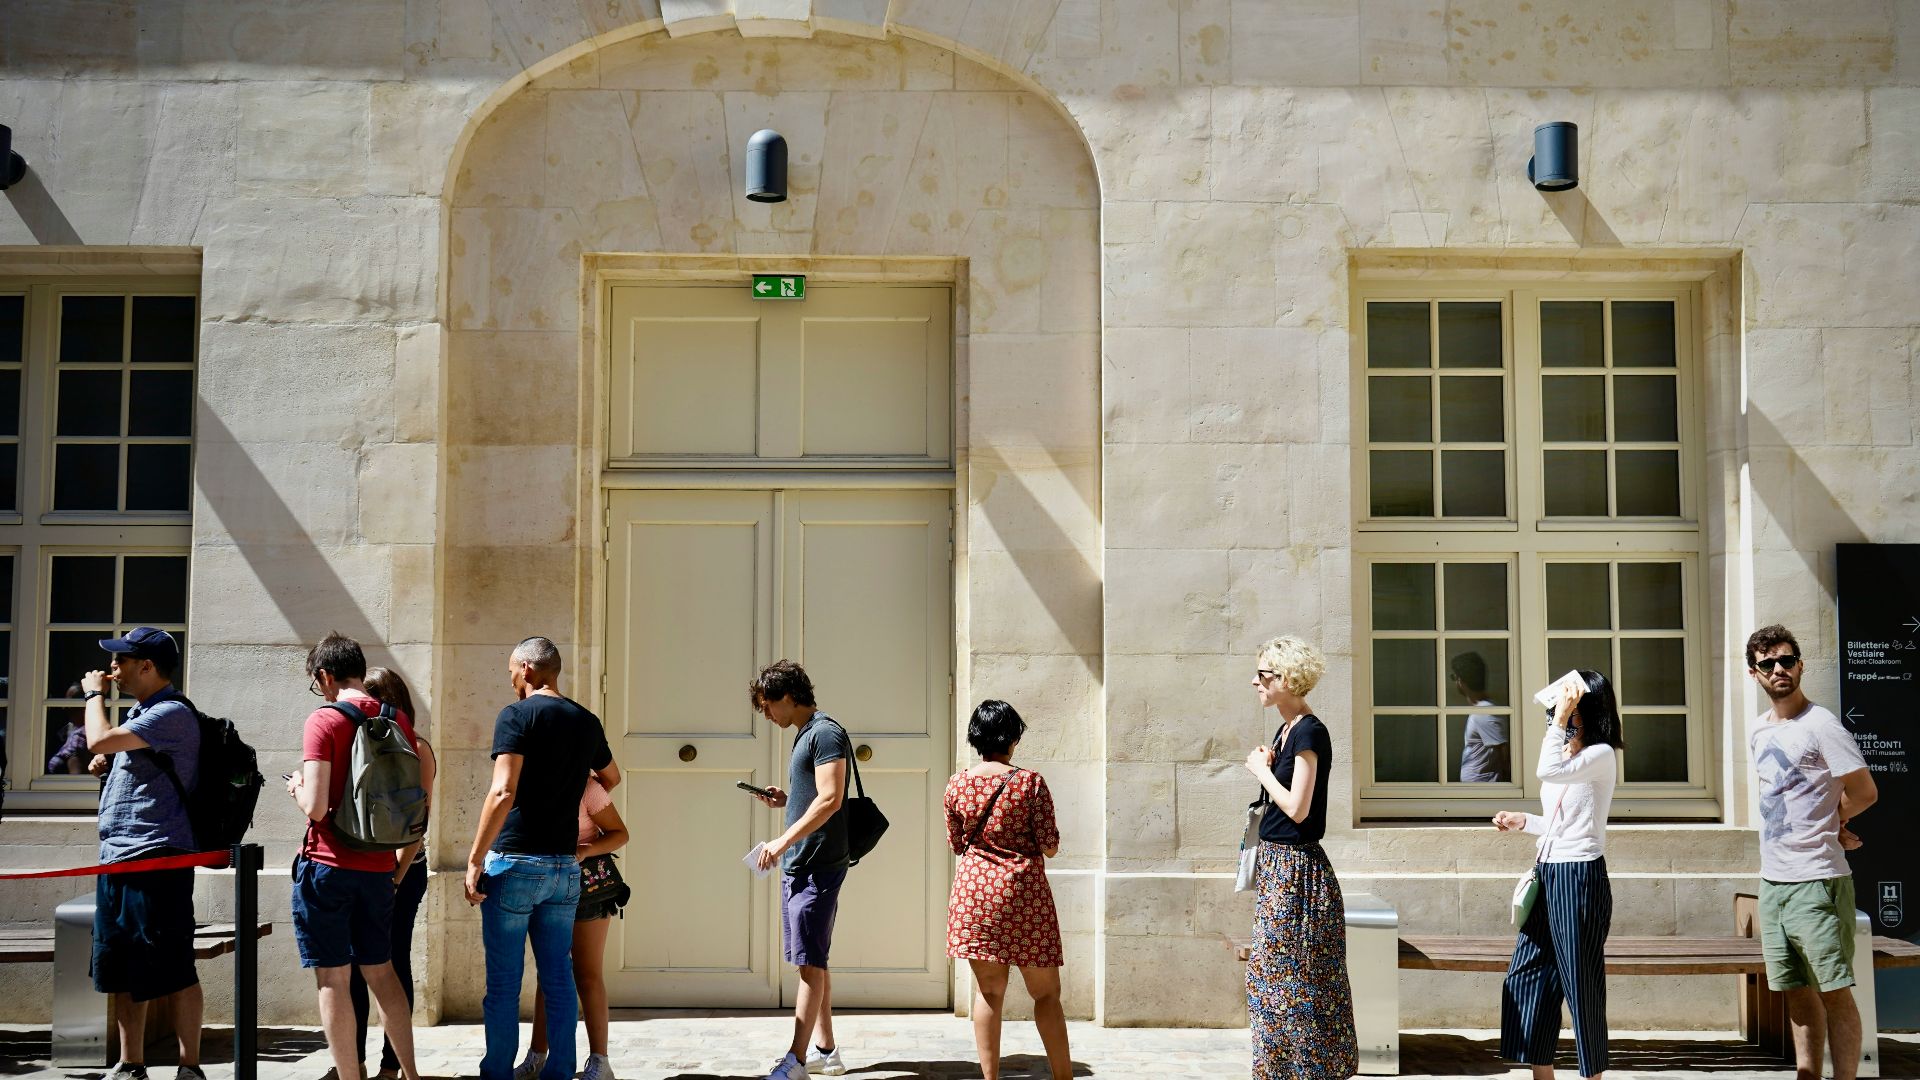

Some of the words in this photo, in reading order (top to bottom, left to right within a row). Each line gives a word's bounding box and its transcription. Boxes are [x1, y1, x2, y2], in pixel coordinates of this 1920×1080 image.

[1847, 641, 1890, 649] Billetterie
[1847, 650, 1885, 658] Vestiaire
[1848, 672, 1877, 681] Frappé
[1873, 741, 1902, 749] CONTI
